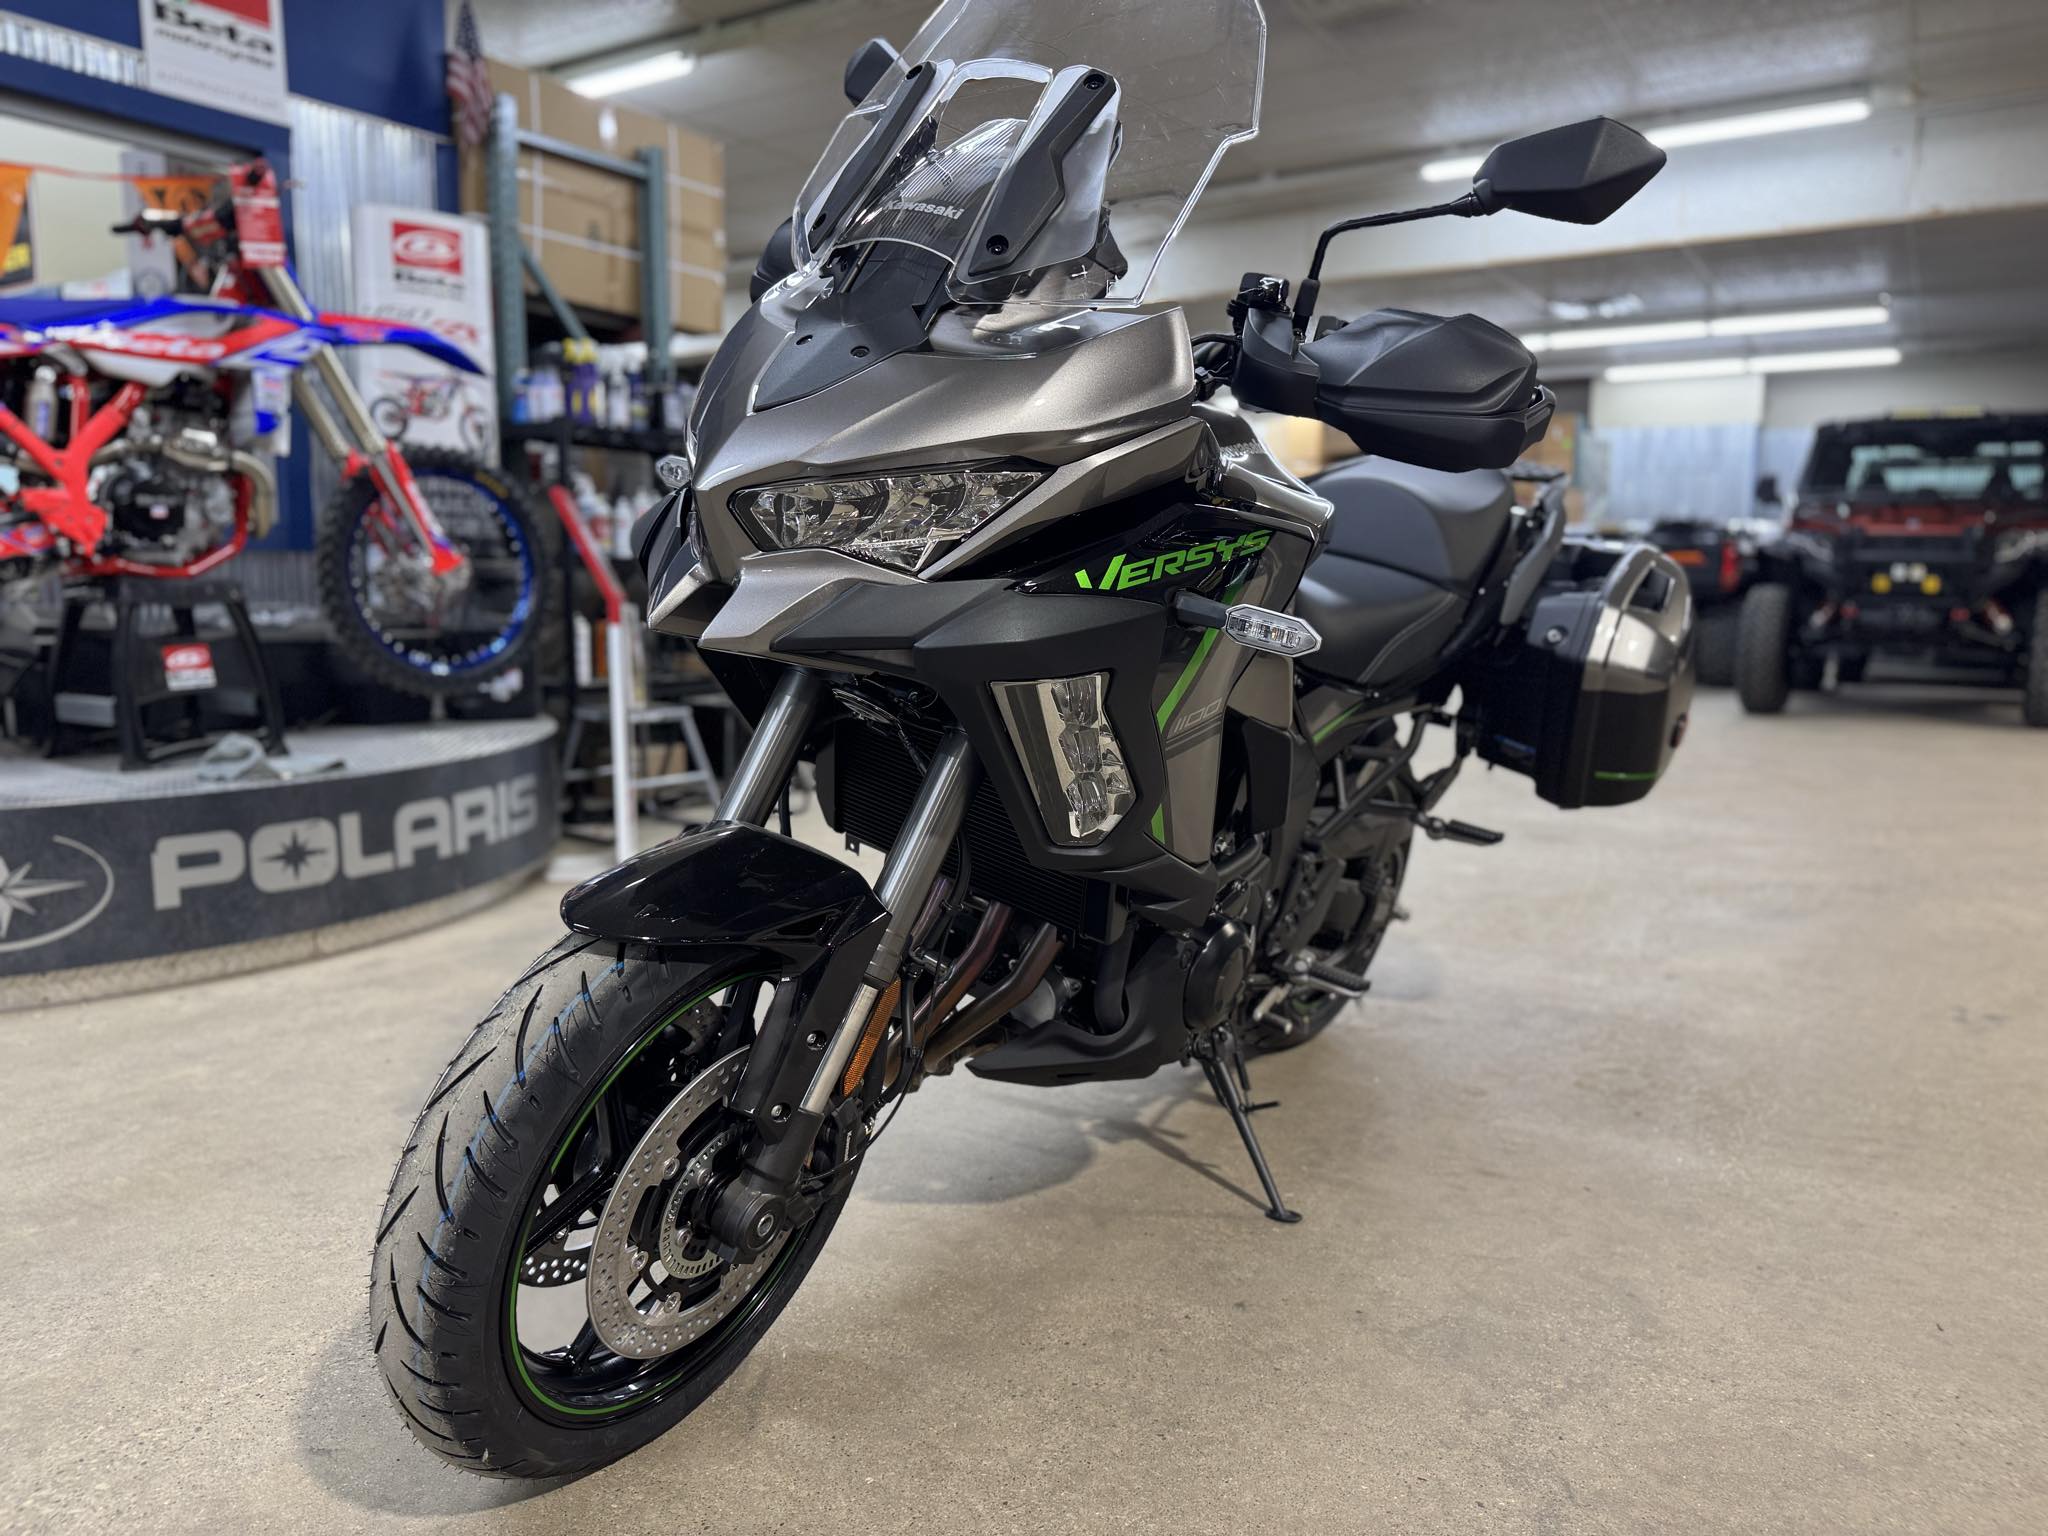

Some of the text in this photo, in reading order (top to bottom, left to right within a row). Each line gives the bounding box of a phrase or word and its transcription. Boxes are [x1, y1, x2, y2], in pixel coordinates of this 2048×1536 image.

[883, 200, 965, 220] Kawasaki
[1075, 529, 1273, 591] VERSYS
[153, 774, 538, 911] POLARIS
